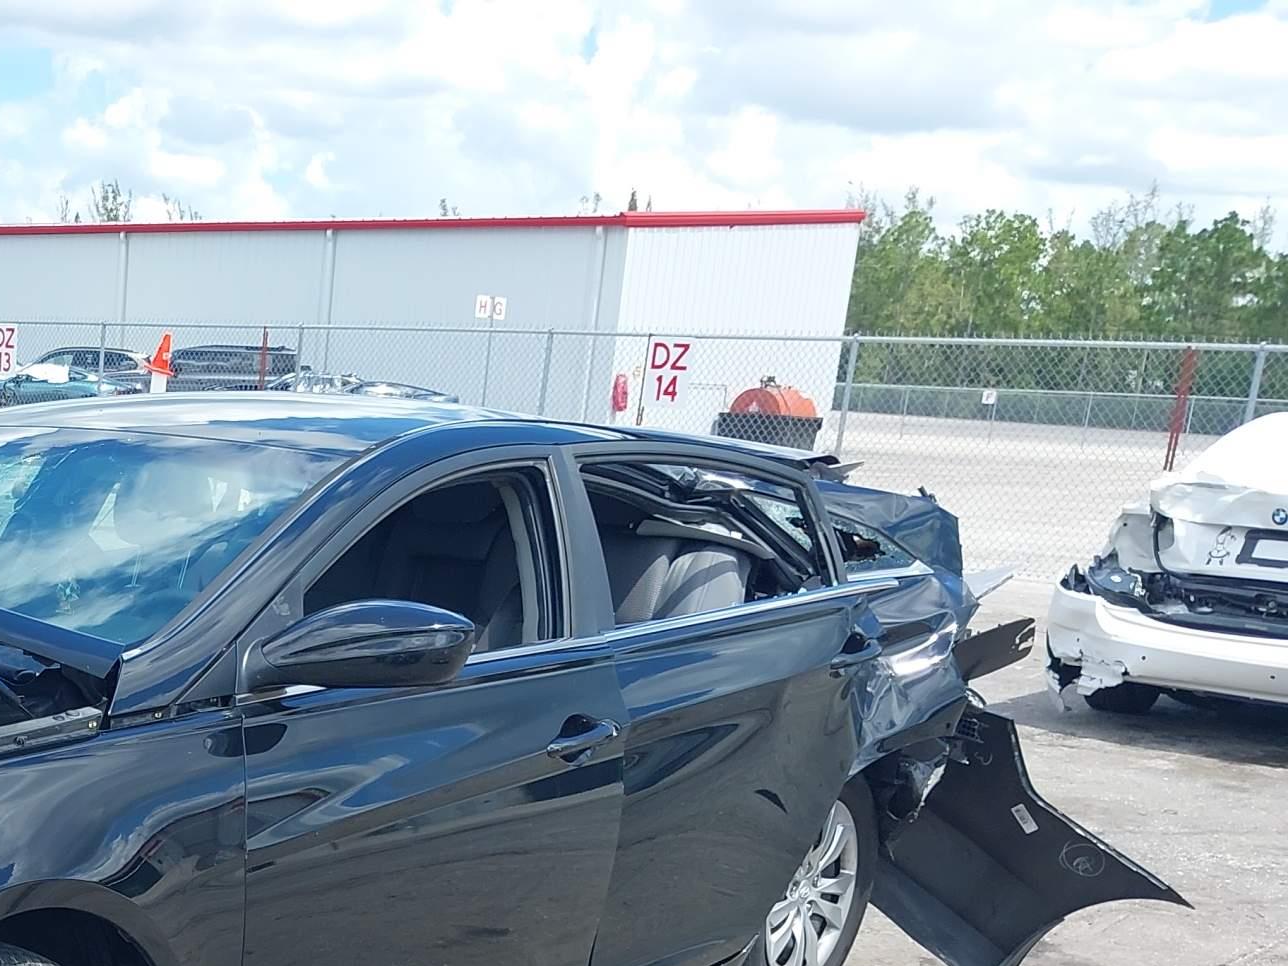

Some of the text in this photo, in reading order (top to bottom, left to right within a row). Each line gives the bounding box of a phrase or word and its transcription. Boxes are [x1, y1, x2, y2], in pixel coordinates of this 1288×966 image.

[479, 299, 488, 315] H
[494, 301, 503, 316] G
[651, 342, 690, 371] DZ
[655, 374, 678, 402] 14
